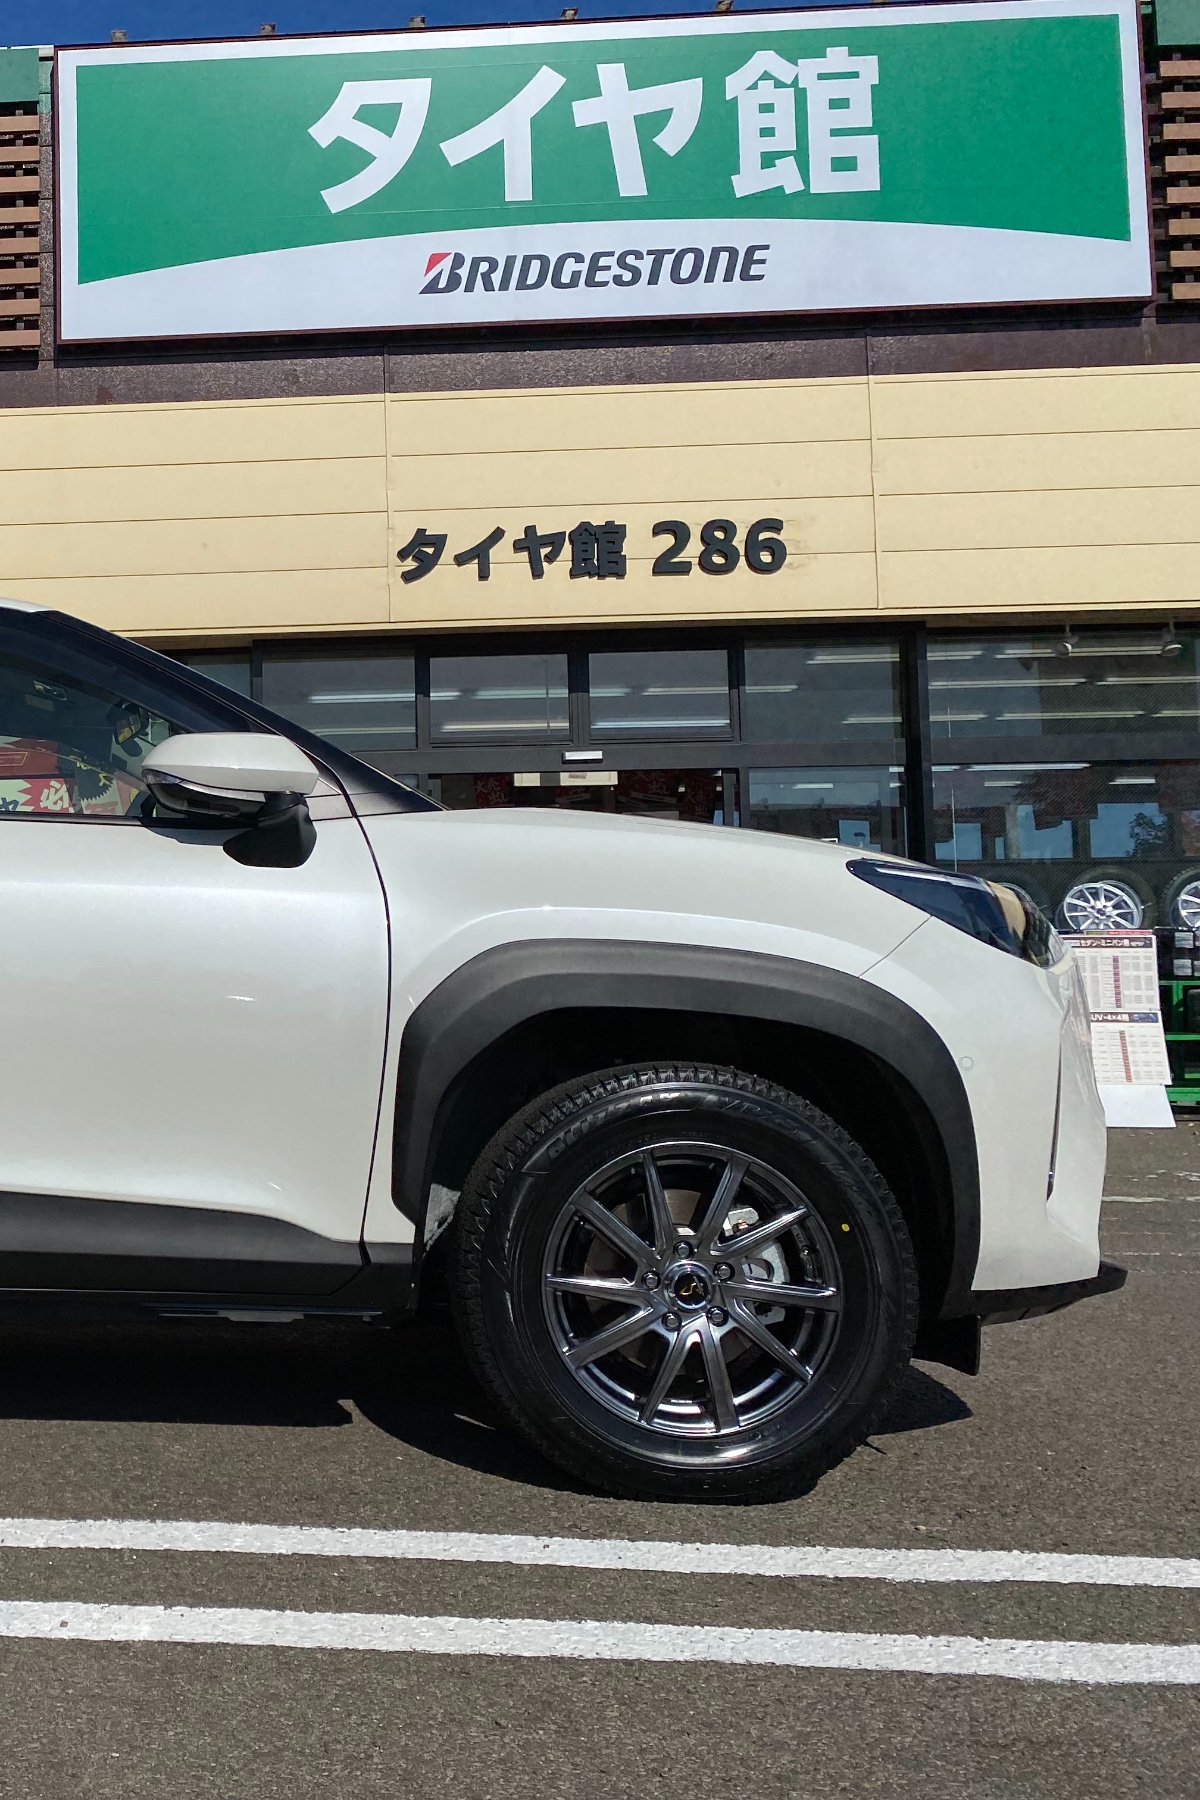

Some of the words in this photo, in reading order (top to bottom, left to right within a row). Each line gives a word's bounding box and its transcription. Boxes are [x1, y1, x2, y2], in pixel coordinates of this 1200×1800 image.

[307, 46, 882, 214] タイヤ館
[418, 243, 770, 296] BRIDGESTONE
[396, 520, 627, 583] タイヤ館
[651, 517, 788, 576] 286
